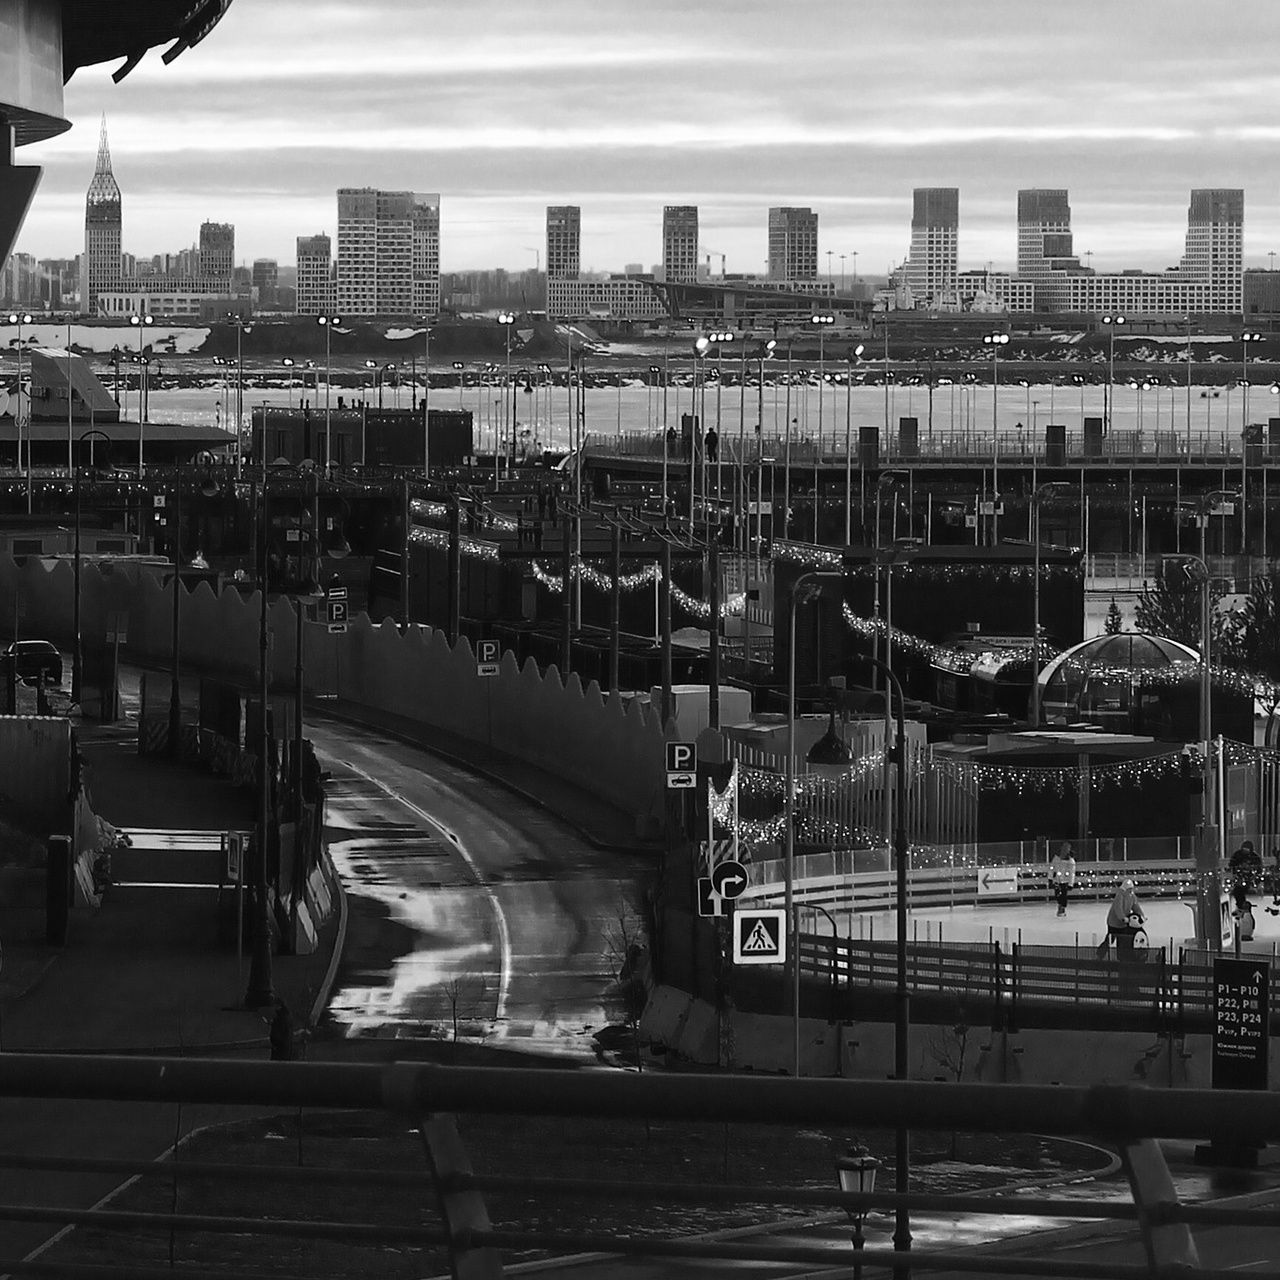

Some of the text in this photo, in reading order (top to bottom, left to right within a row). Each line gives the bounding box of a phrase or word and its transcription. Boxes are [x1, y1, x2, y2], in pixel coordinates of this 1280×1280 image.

[333, 603, 344, 620] P
[483, 643, 496, 662] P
[674, 745, 691, 769] P
[1218, 984, 1230, 994] P1
[1240, 986, 1259, 996] P10
[1218, 998, 1240, 1009] P22,
[1217, 1011, 1262, 1024] P23, P24
